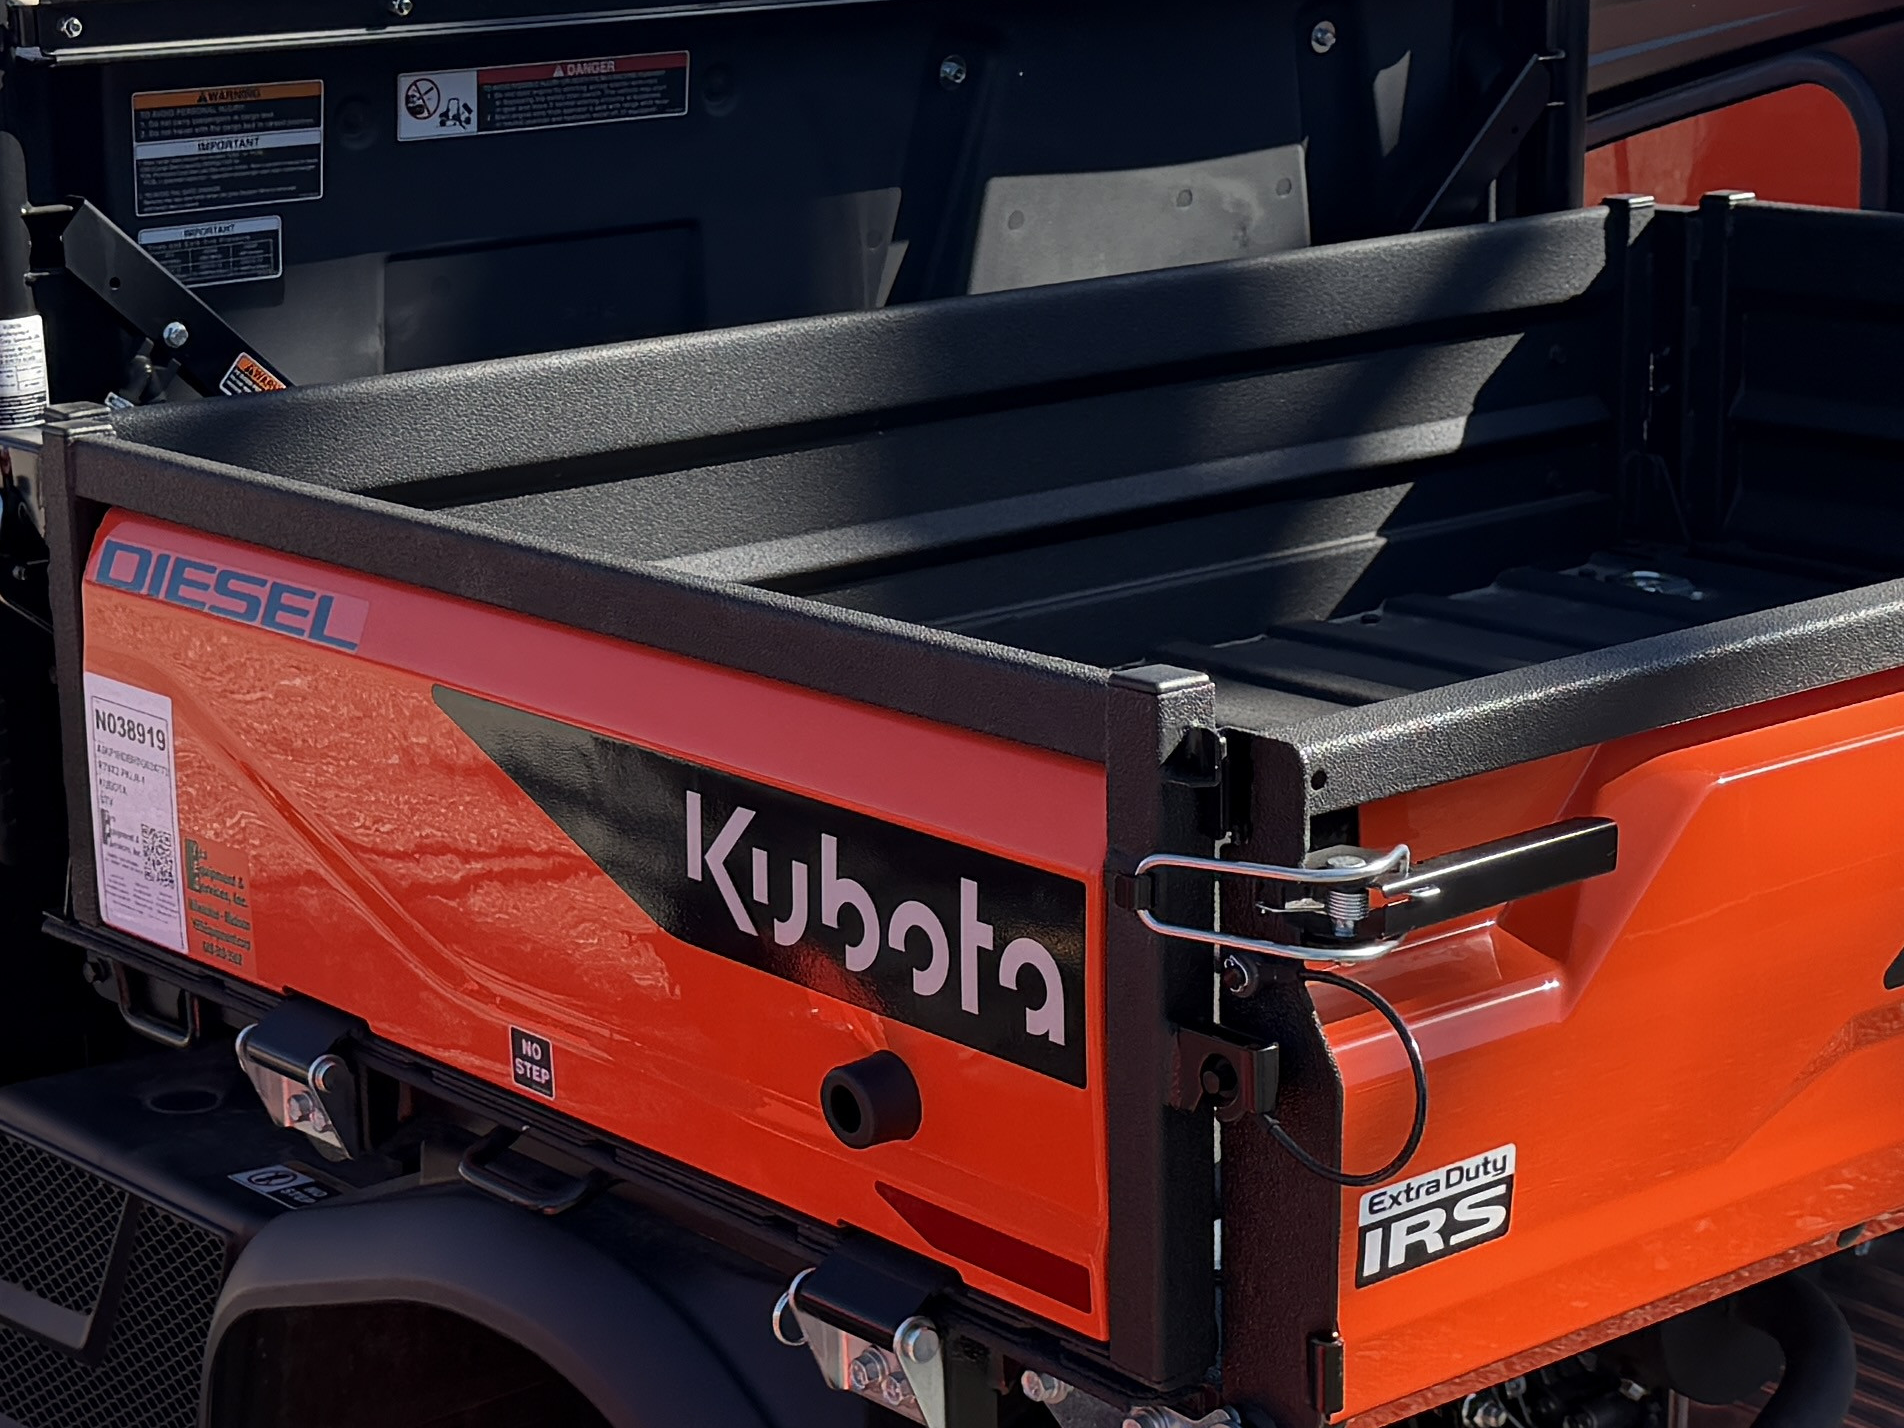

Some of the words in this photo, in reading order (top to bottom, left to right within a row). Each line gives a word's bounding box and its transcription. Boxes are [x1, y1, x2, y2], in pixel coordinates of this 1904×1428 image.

[566, 60, 616, 77] DANGER
[95, 538, 359, 652] DIESEL
[95, 708, 167, 752] N038919
[686, 789, 1066, 1046] Kubota
[514, 1057, 550, 1084] STEP
[521, 1038, 542, 1061] NO
[1367, 1177, 1441, 1215] Extra
[1446, 1154, 1508, 1190] Duty
[1362, 1183, 1507, 1278] IRS
